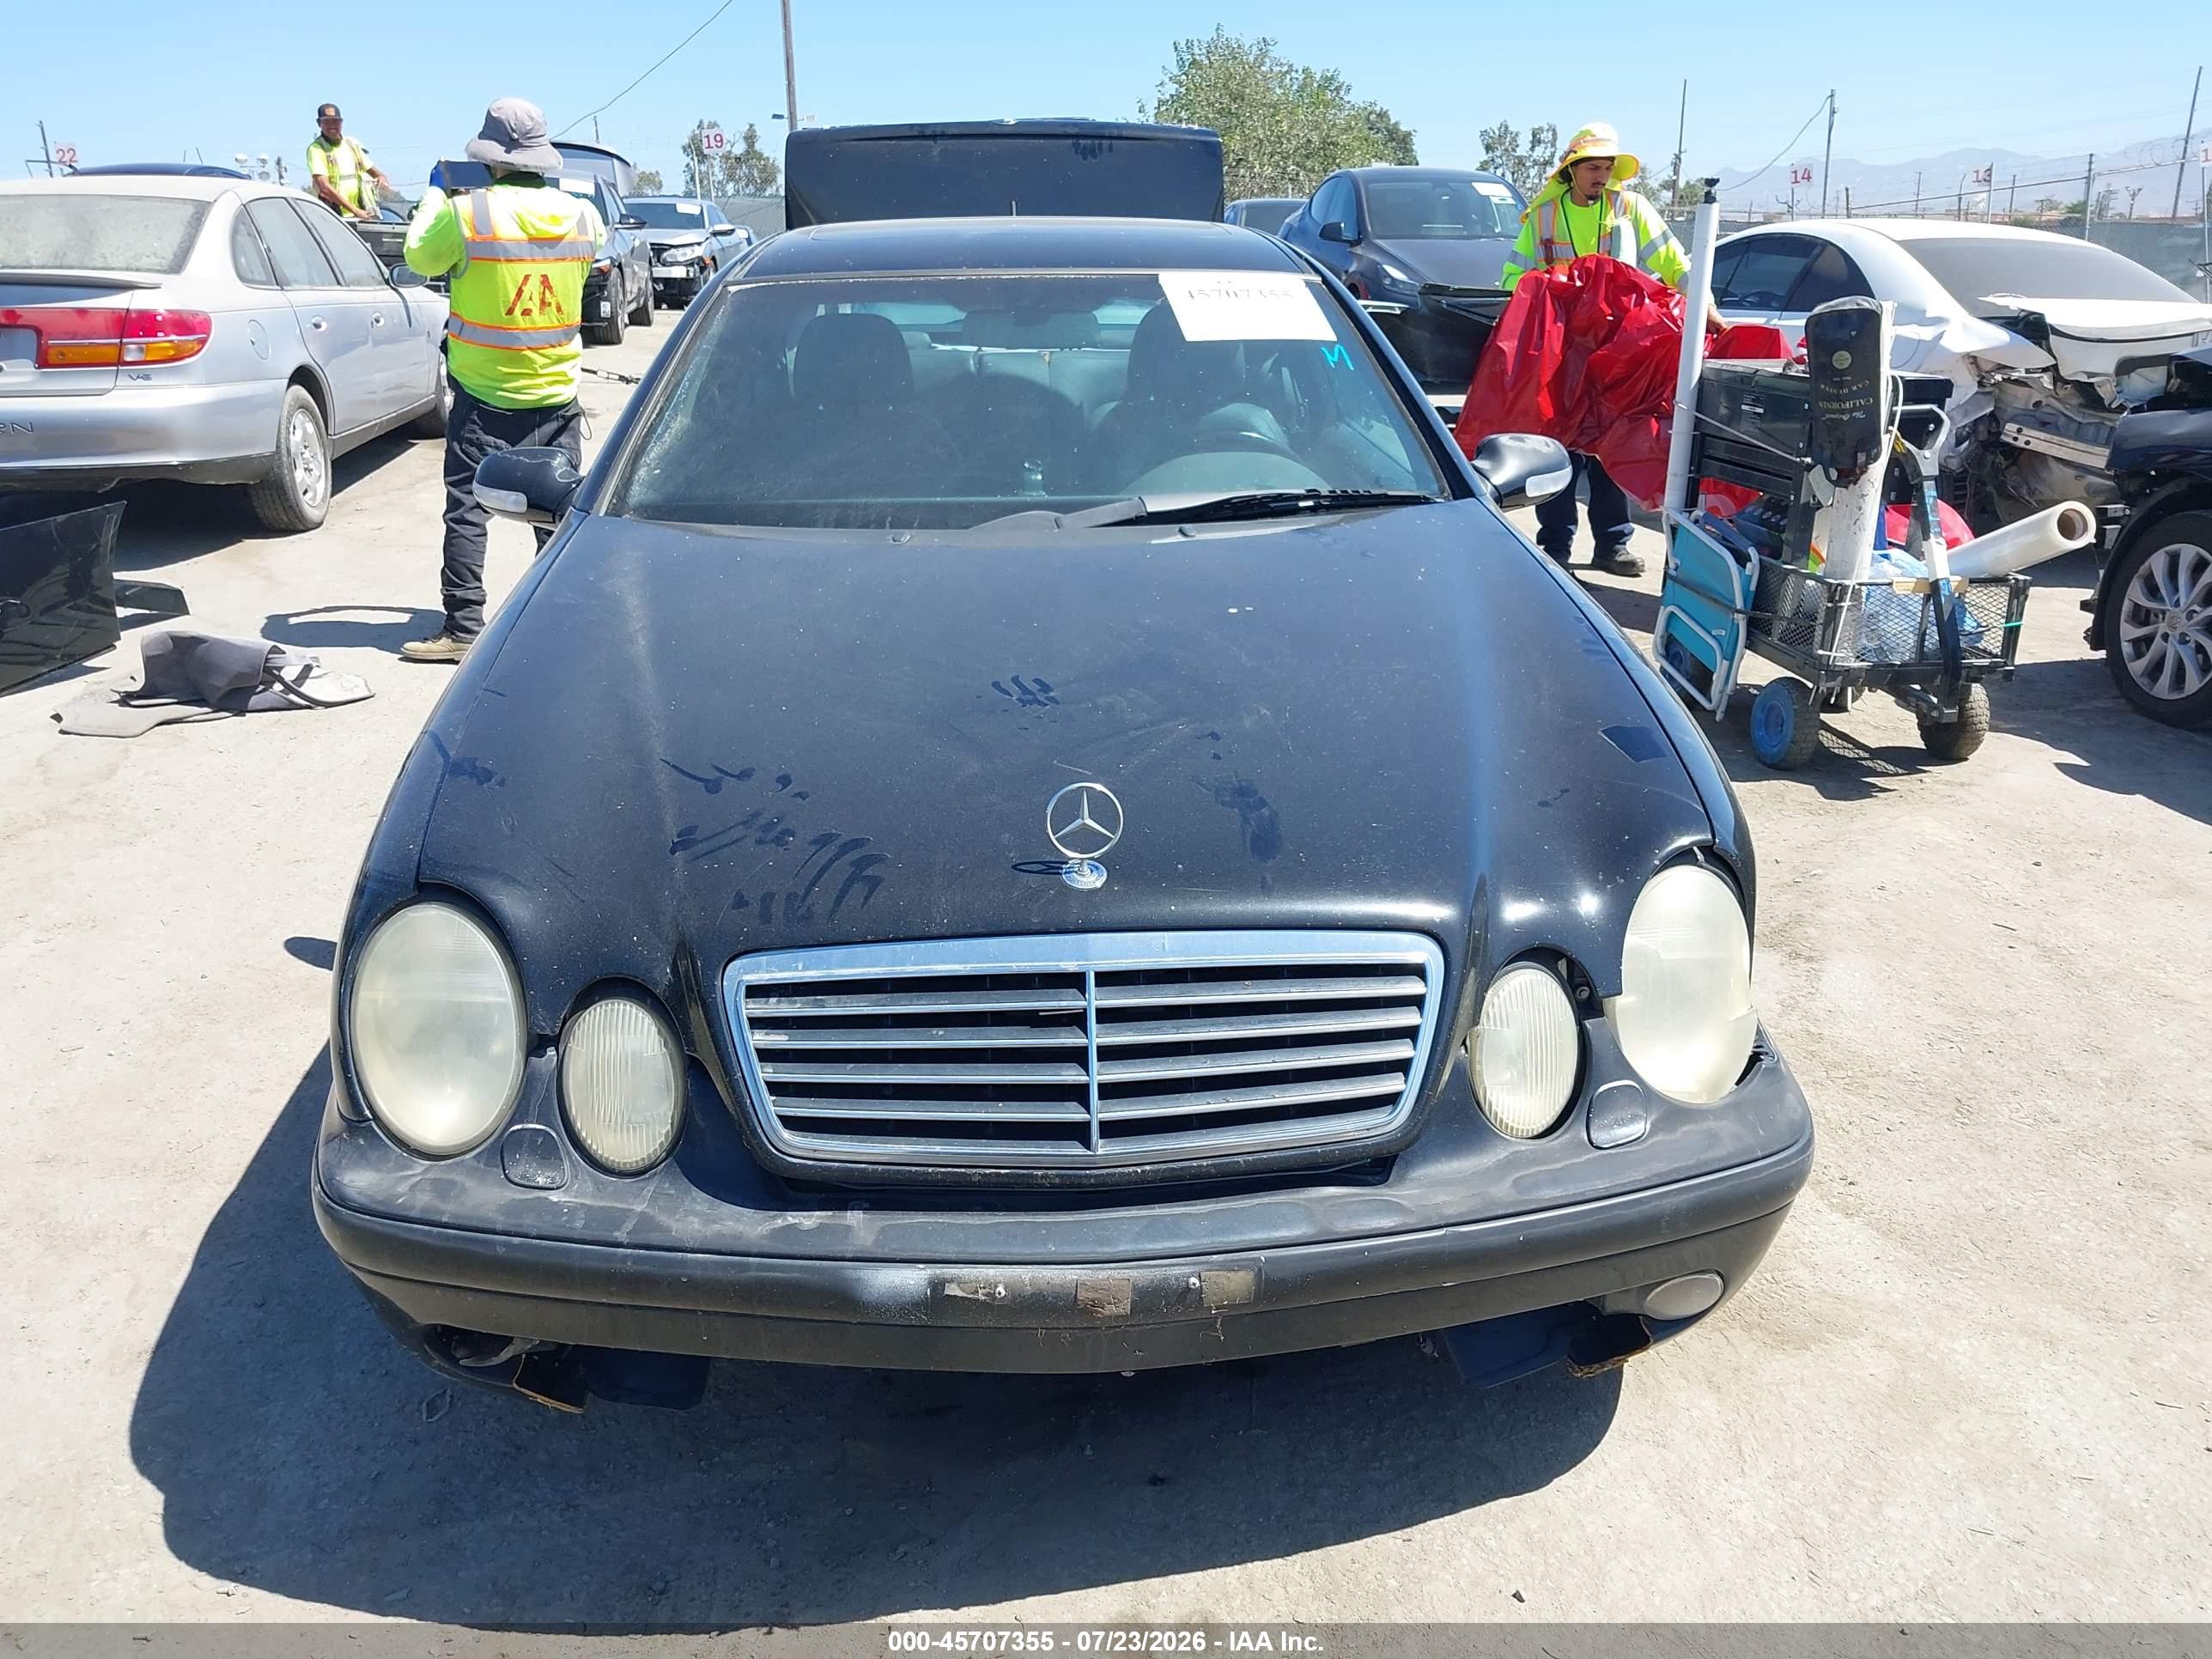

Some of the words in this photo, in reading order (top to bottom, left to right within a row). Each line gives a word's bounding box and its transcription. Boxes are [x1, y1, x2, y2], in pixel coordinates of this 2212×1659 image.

[704, 133, 724, 149] 19
[56, 148, 78, 163] 22
[1790, 167, 1812, 185] 14
[1972, 168, 1991, 183] 13
[1819, 397, 1874, 410] CALIFORNIA
